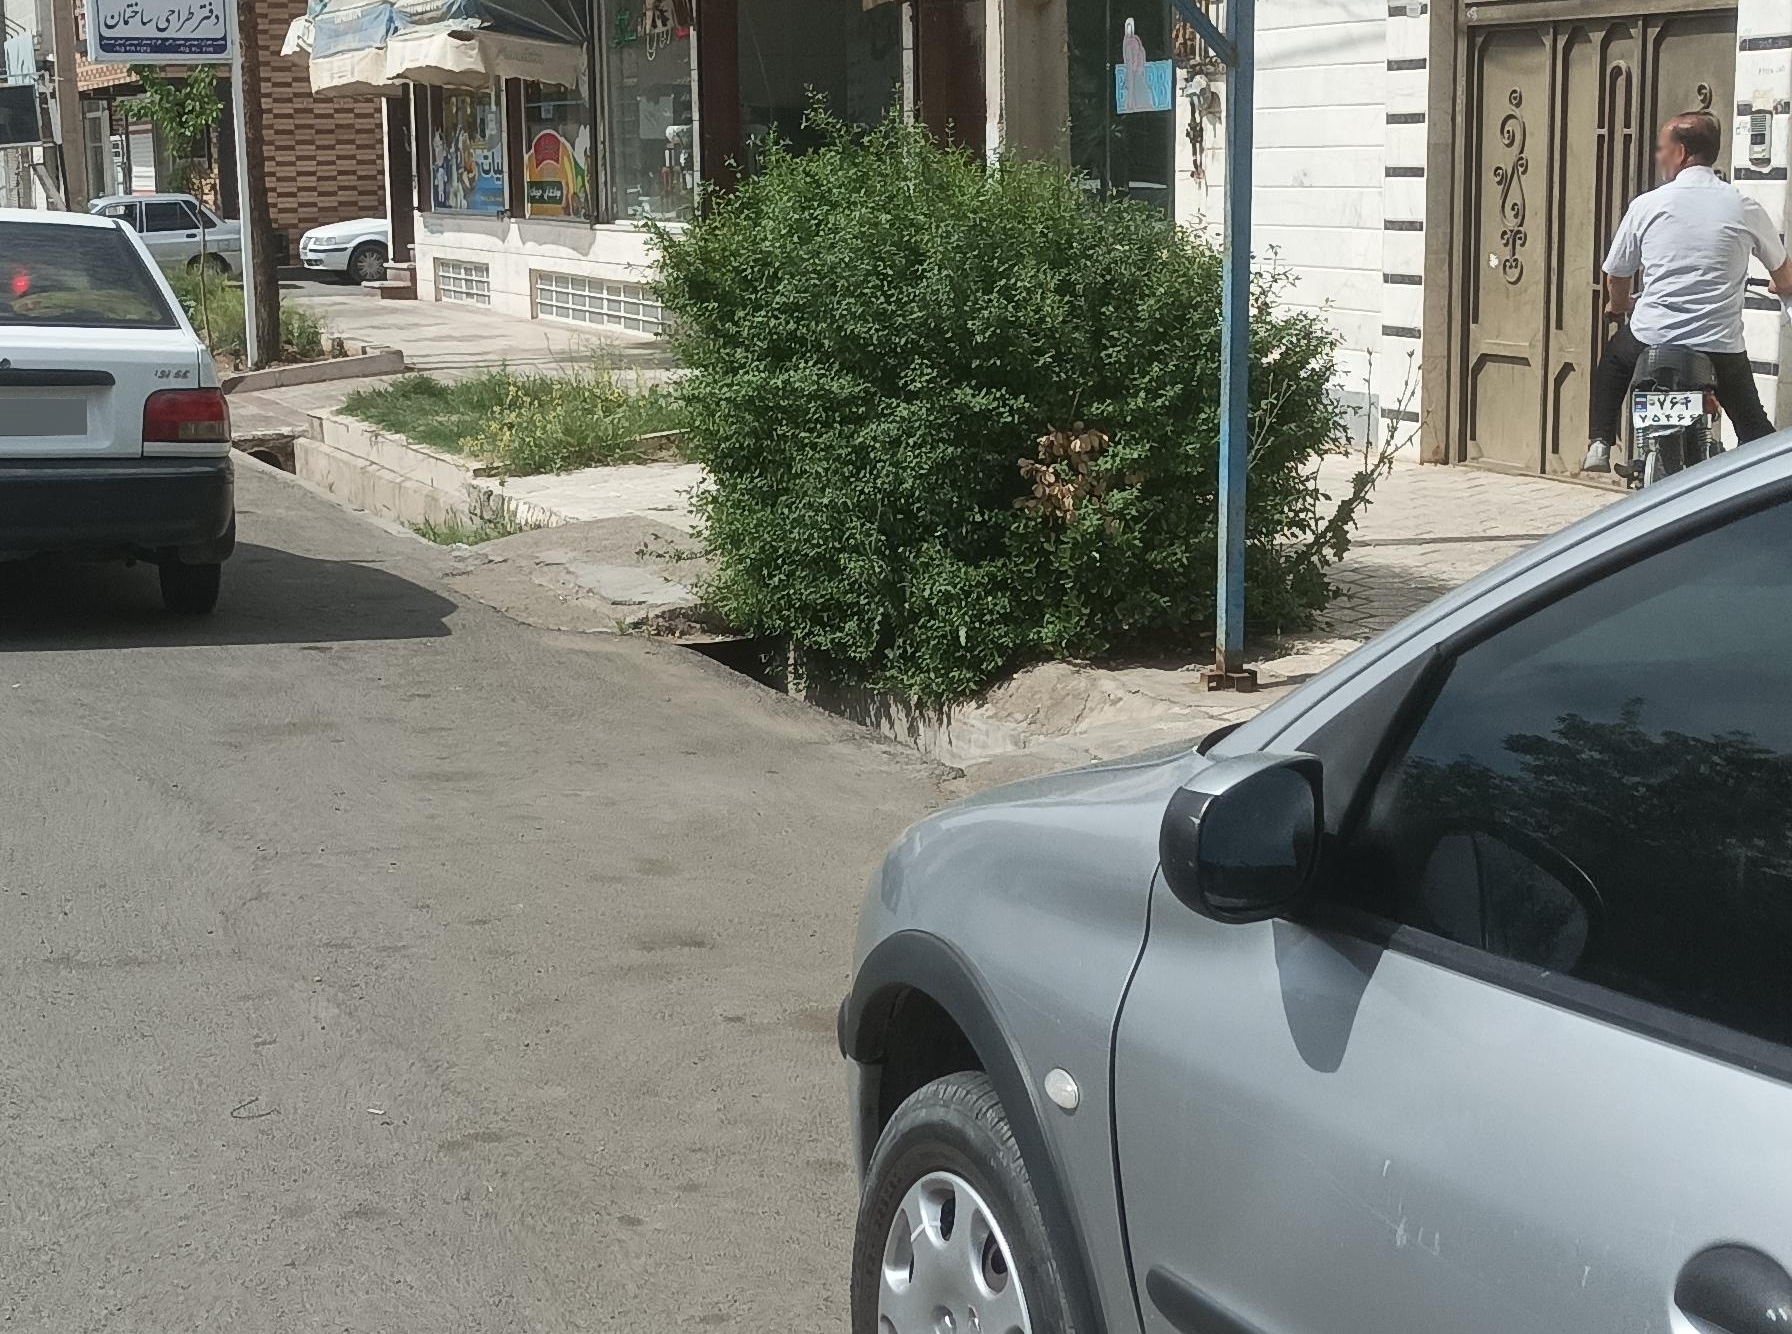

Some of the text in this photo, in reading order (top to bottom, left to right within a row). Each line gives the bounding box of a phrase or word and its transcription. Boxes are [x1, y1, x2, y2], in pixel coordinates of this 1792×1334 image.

[103, 1, 220, 34] دفتر طراحی ساختمان
